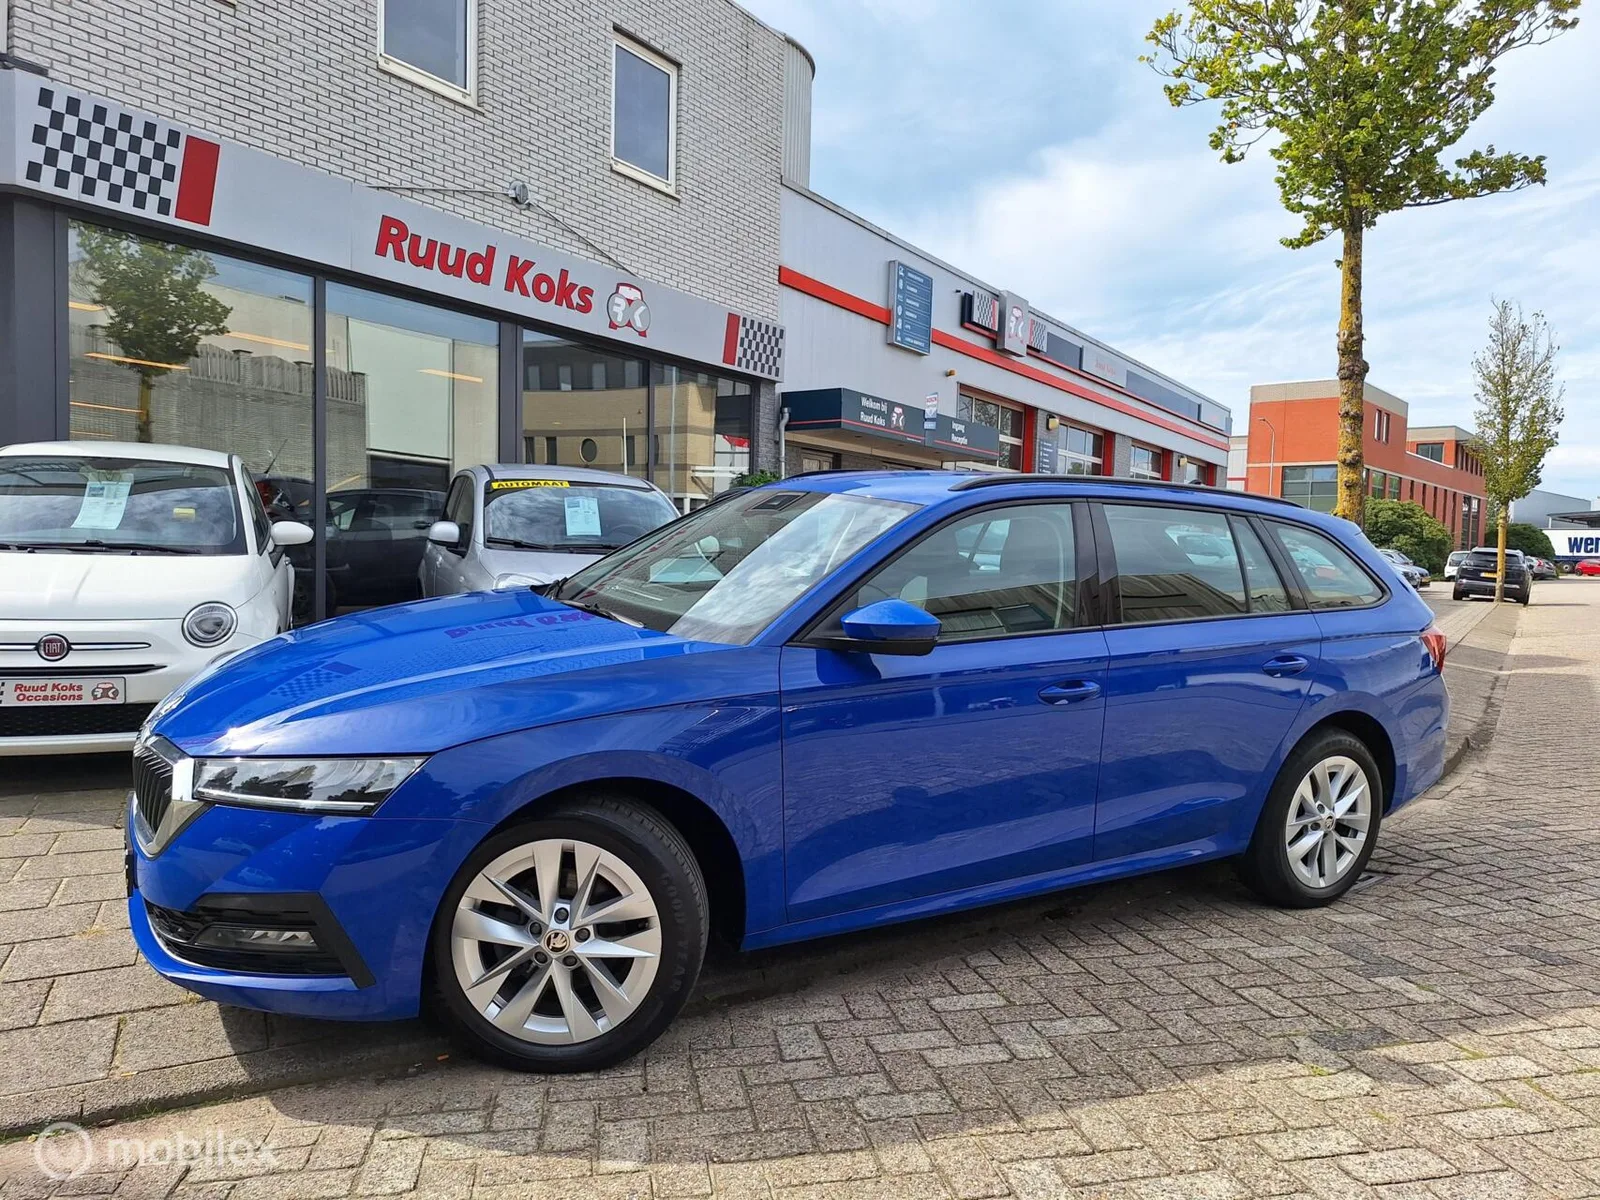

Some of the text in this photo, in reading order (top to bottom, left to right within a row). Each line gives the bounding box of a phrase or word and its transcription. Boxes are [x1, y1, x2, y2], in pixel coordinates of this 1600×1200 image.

[375, 214, 595, 315] Ruud Koks
[861, 396, 880, 411] Welkom
[860, 411, 886, 427] Ruud Koks
[45, 642, 61, 654] FIAT
[14, 683, 83, 692] Ruud Koks
[16, 692, 83, 702] Occasions
